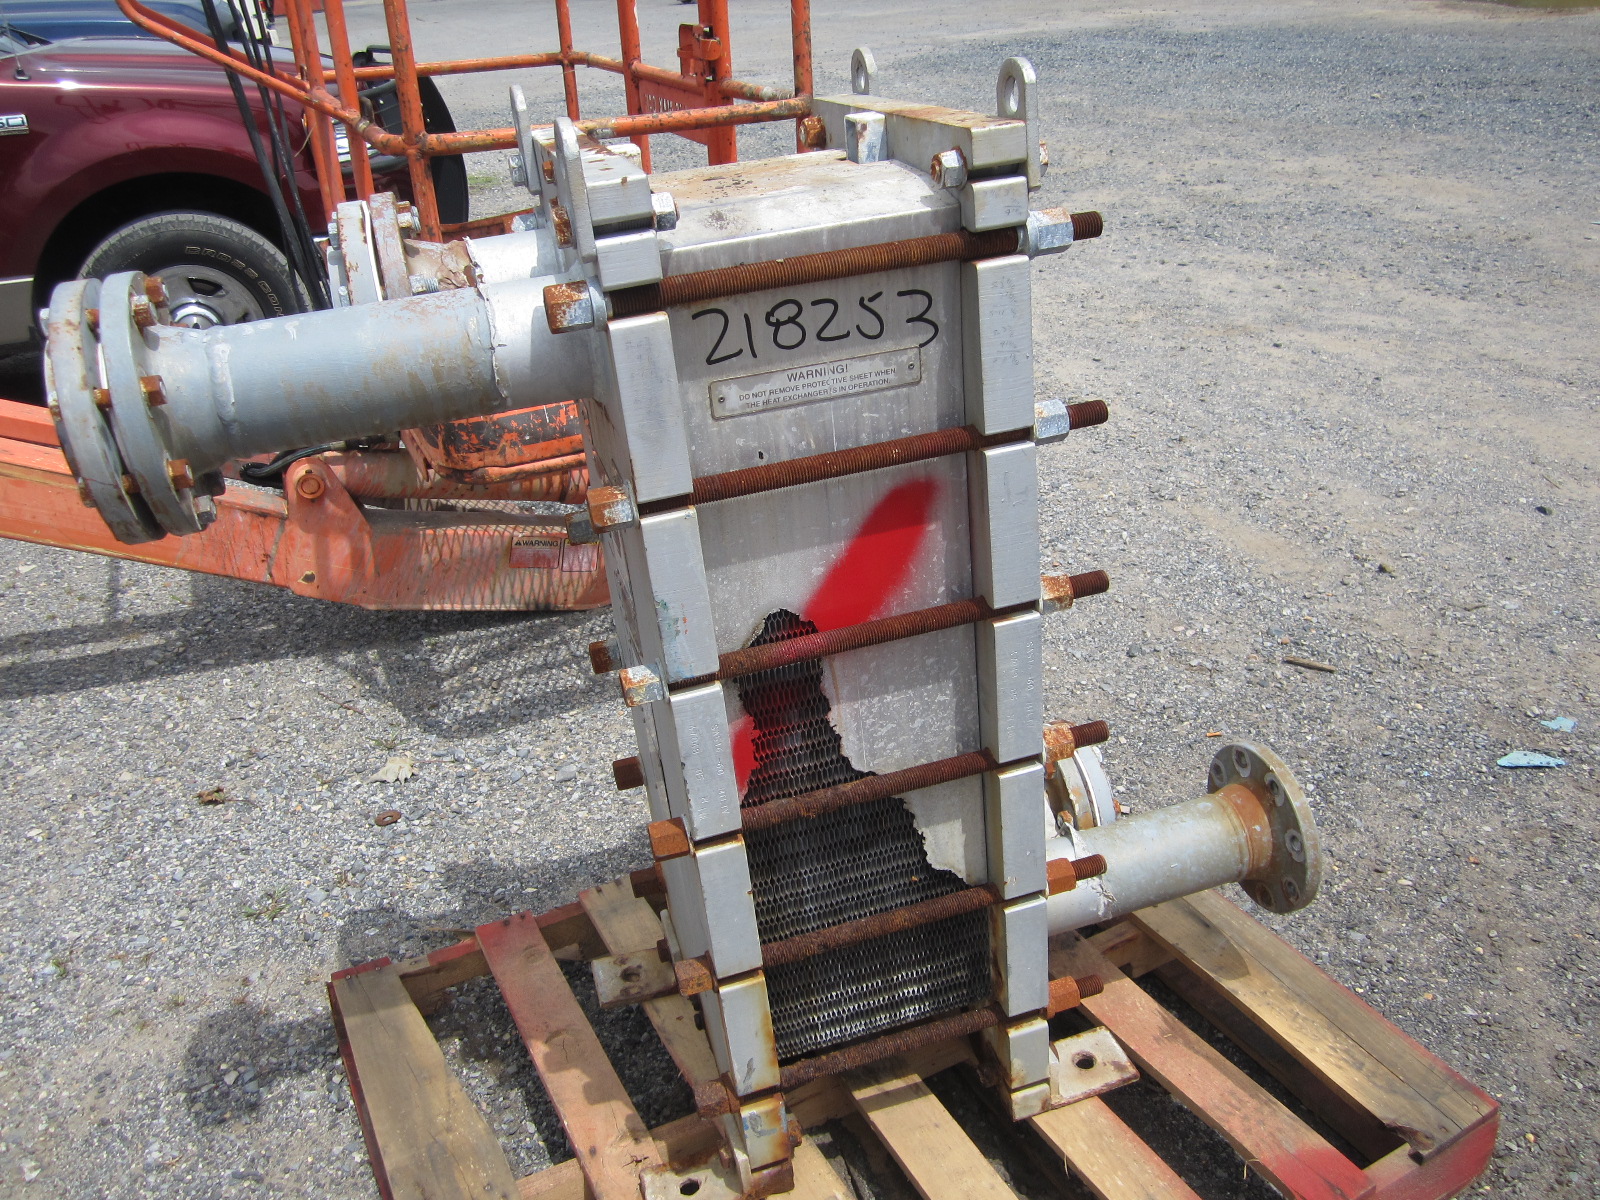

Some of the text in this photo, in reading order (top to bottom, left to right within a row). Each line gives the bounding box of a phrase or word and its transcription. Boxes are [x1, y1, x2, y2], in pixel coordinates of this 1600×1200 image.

[691, 288, 940, 366] 218253
[738, 367, 897, 402] DO NOT REMOVE PROTECTIVE SHEET WHEN
[786, 363, 849, 383] WARNING!
[745, 378, 891, 409] THE HEAT EXCHANGER IS IN OPERATION.
[522, 539, 559, 547] WARNING
